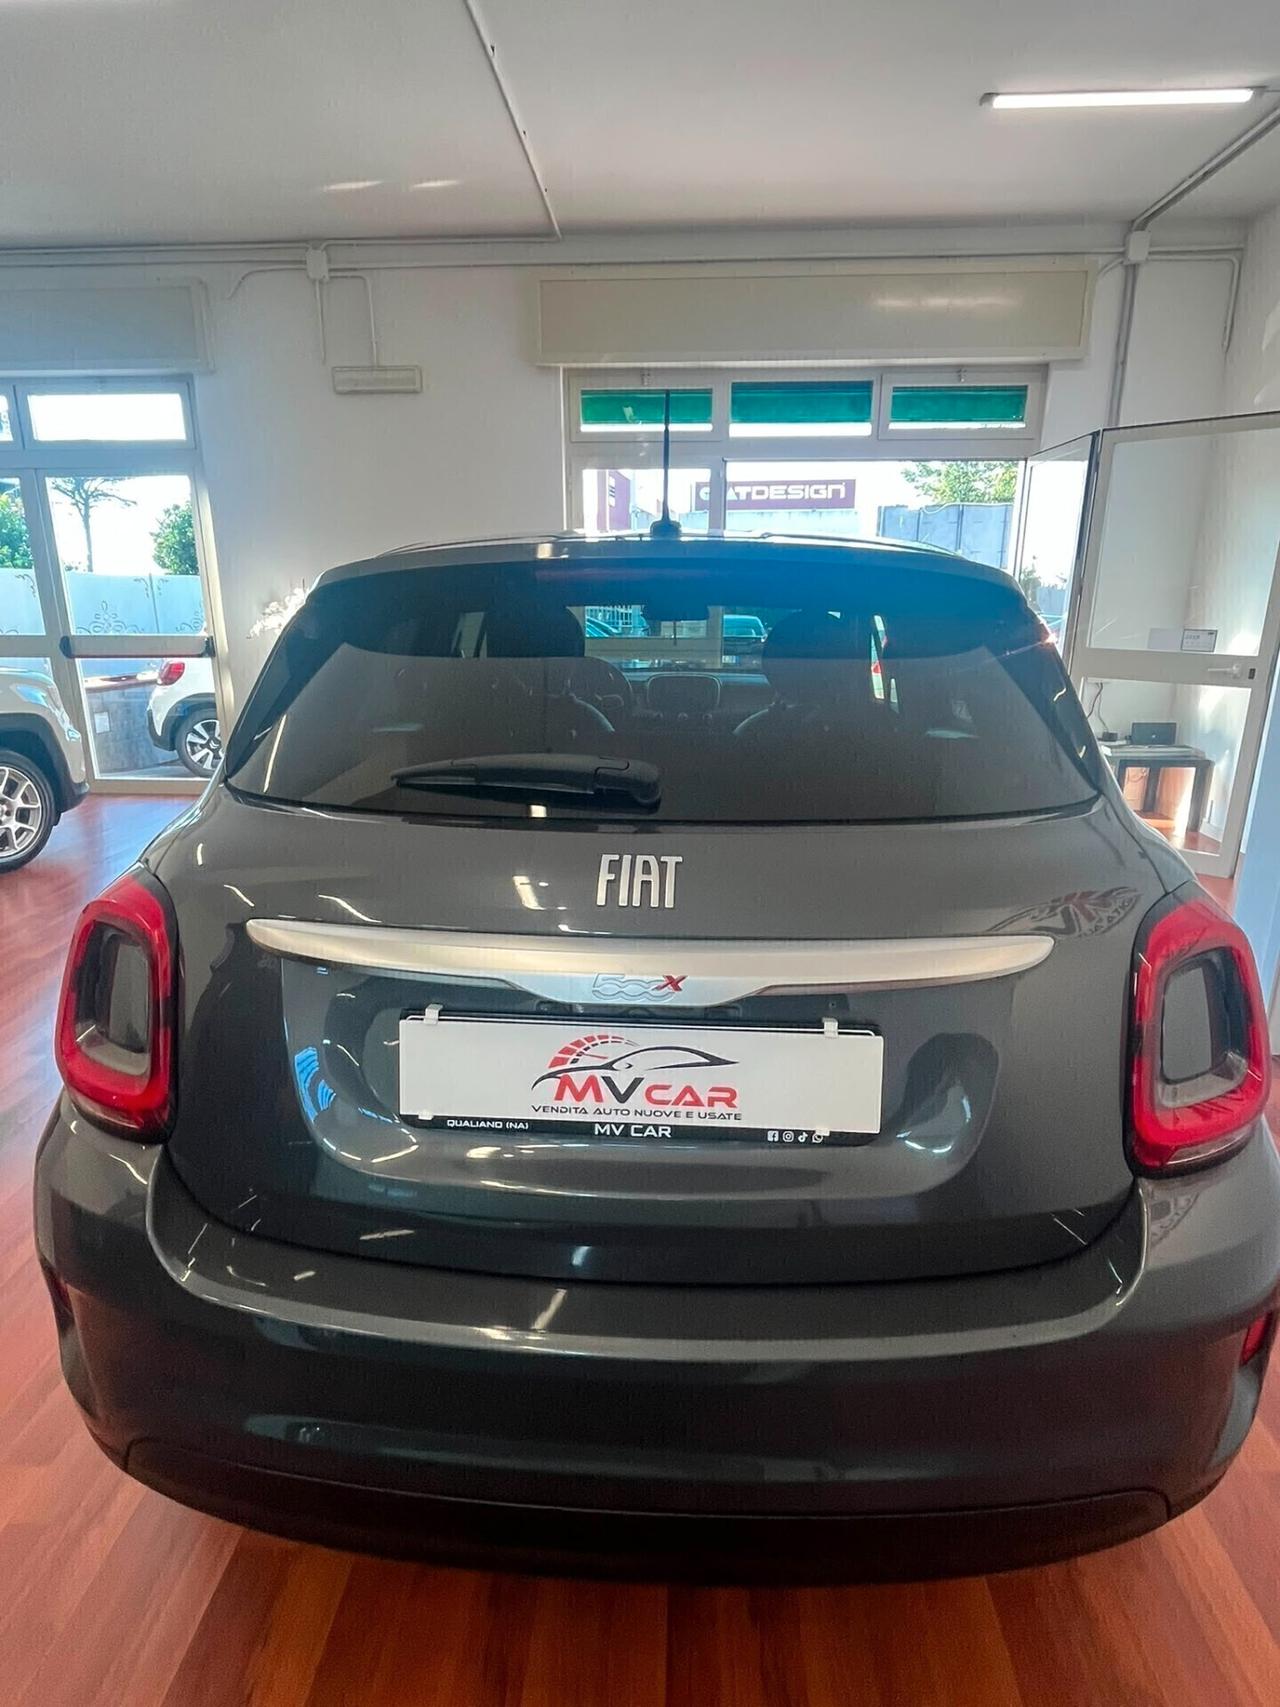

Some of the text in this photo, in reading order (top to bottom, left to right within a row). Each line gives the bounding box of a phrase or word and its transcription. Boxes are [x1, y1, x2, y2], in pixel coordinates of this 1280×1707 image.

[596, 854, 683, 908] FIAT
[531, 1104, 742, 1121] VENDITA AUTO NUOVE E USATE
[446, 1119, 529, 1130] QUALIANO (NA)
[594, 1123, 672, 1139] MV CAR
